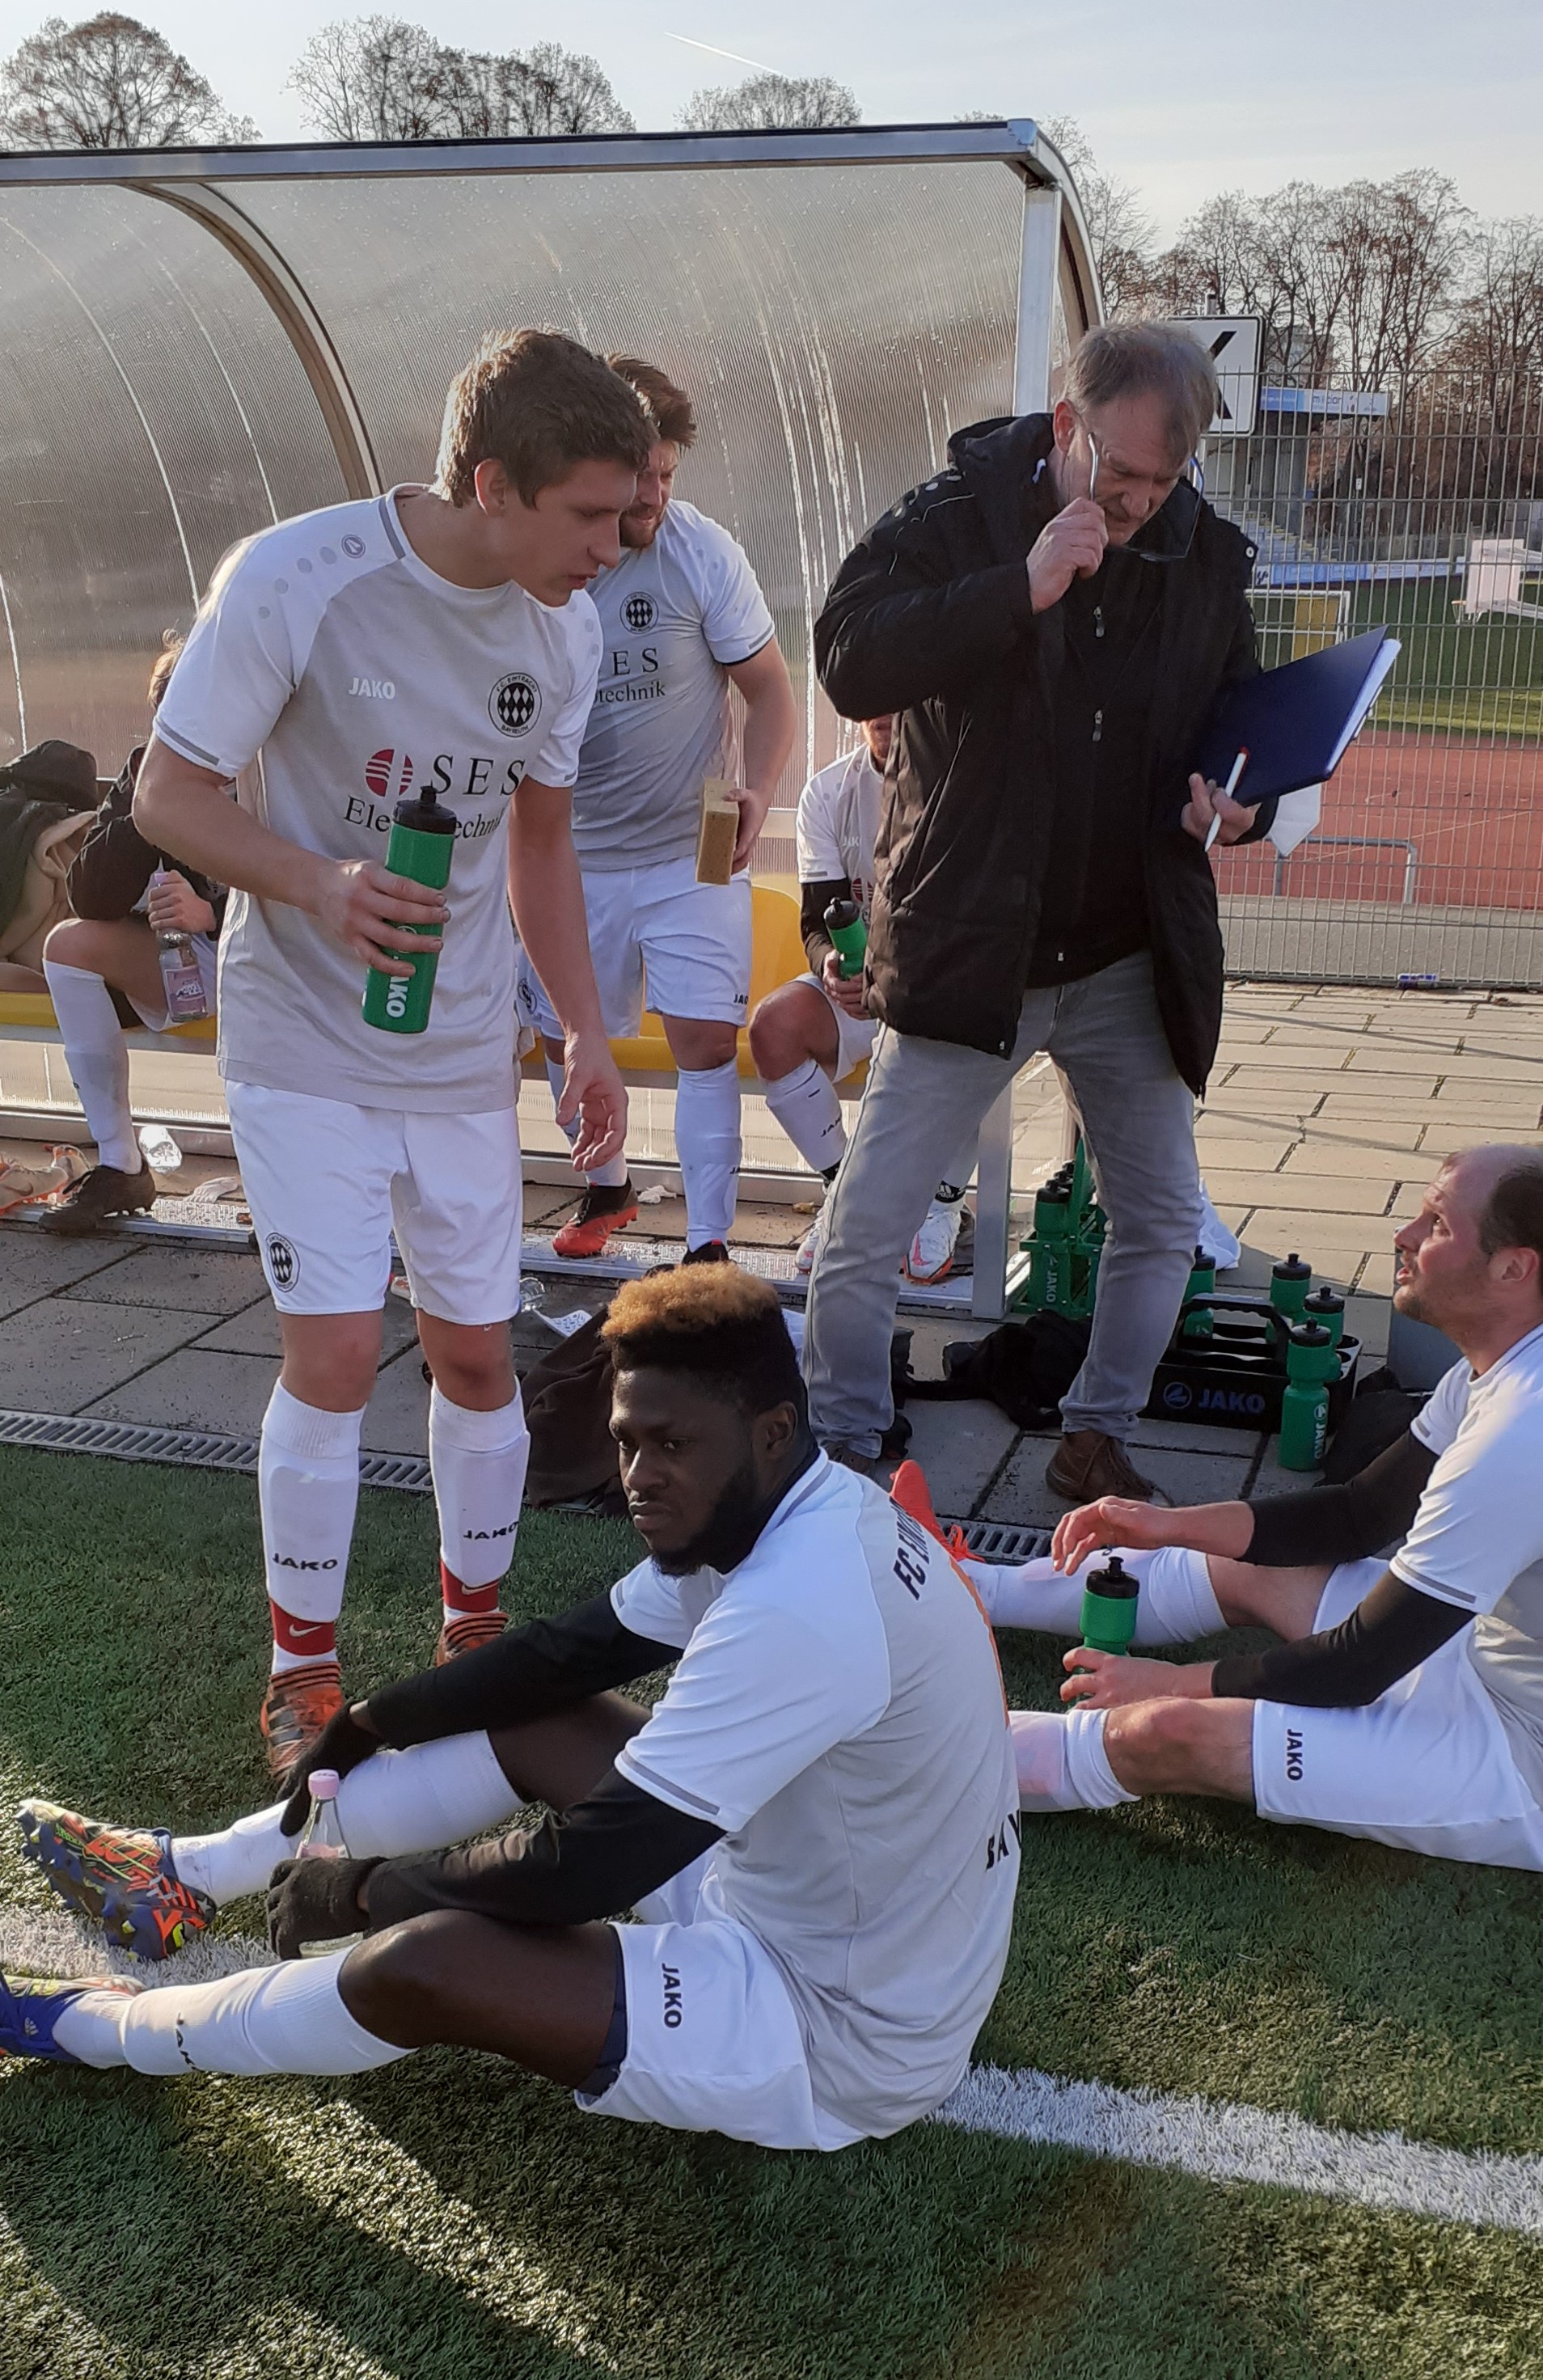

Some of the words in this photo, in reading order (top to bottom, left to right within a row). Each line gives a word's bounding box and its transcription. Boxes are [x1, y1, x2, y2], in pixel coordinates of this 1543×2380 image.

[611, 647, 659, 676] ES
[349, 677, 396, 700] JAKO
[386, 955, 410, 1018] KO
[1046, 1270, 1058, 1303] JAKO
[1198, 1388, 1266, 1414] JAKO
[1314, 1423, 1325, 1460] JAKO
[463, 1520, 519, 1540] JAKO
[272, 1553, 338, 1570] JAKO
[893, 1546, 926, 1600] FC
[1287, 1728, 1304, 1782] JAKO
[662, 1962, 683, 2029] JAKO
